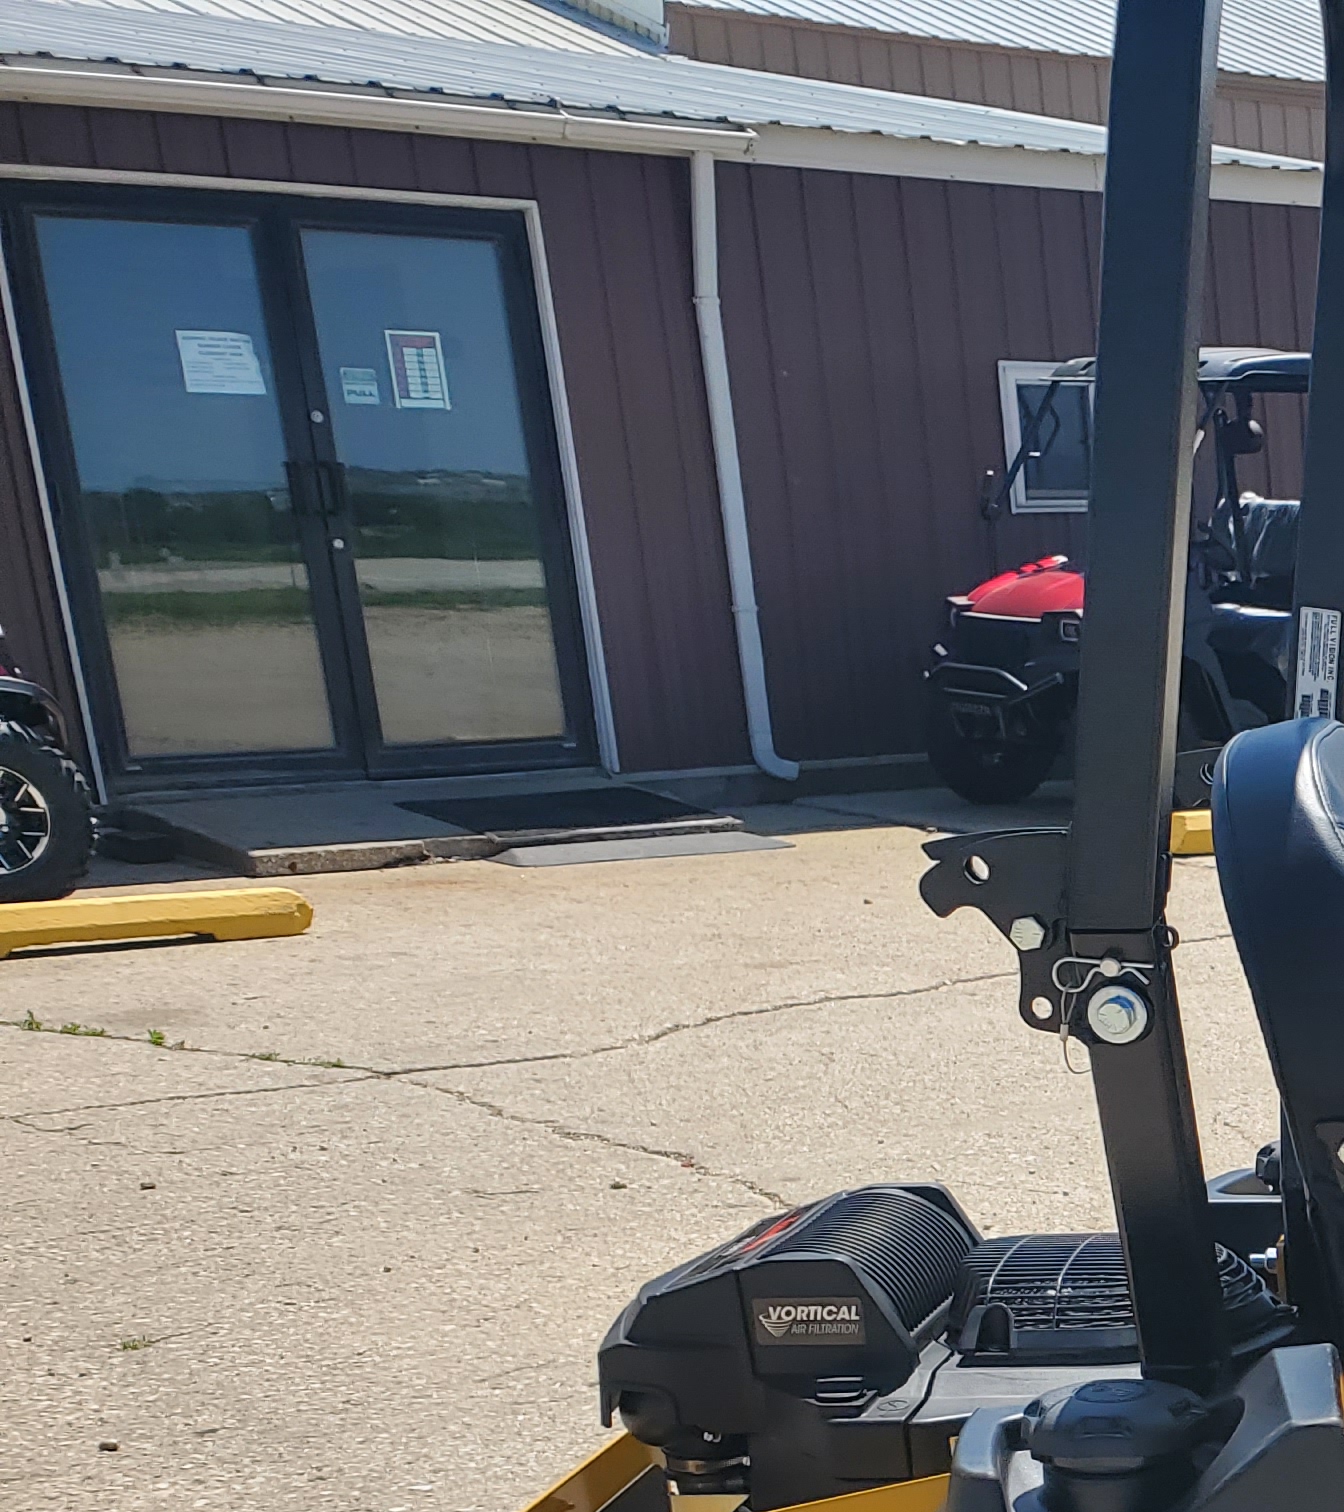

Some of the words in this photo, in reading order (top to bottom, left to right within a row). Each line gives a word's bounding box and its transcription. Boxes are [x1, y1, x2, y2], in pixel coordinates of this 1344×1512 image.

[1330, 615, 1338, 635] FULL
[1327, 637, 1337, 664] VISION
[768, 1305, 860, 1321] VORTICAL
[790, 1323, 807, 1335] AIR
[808, 1323, 860, 1335] FILTRATION
